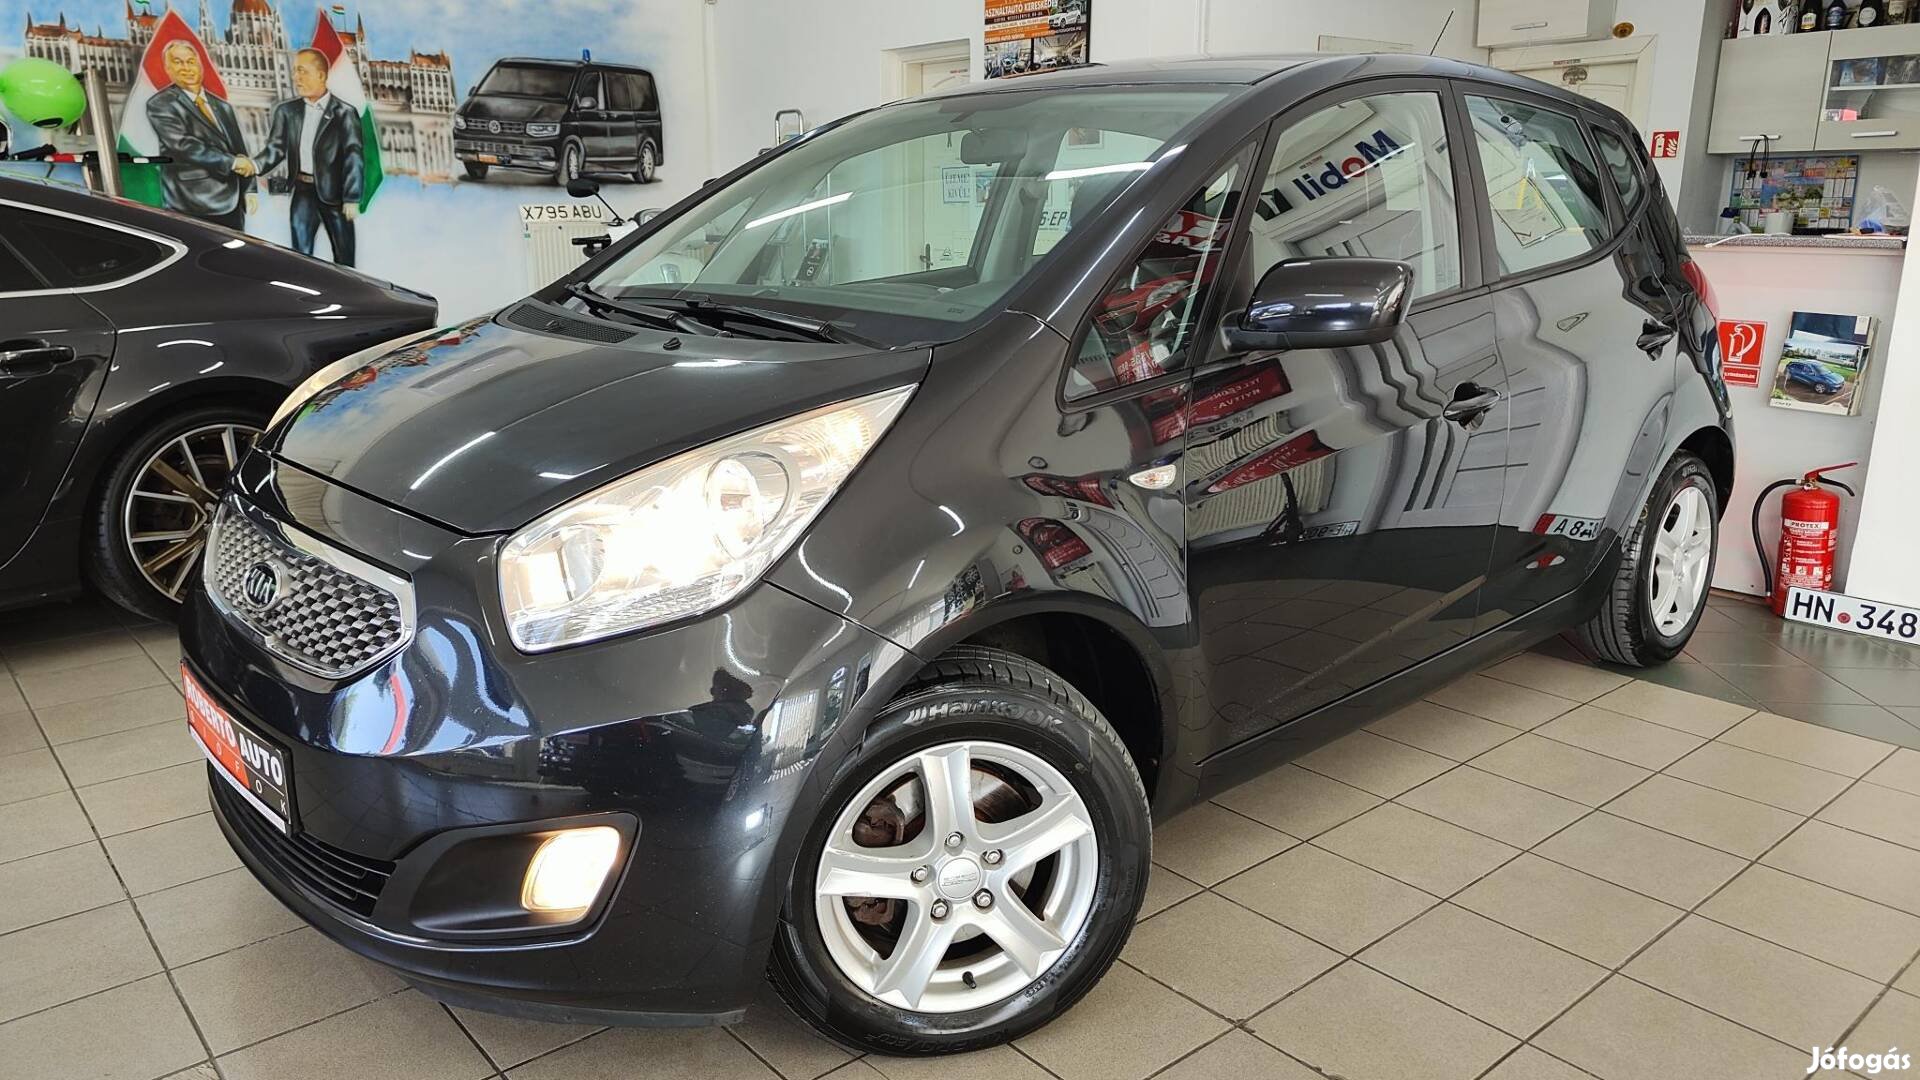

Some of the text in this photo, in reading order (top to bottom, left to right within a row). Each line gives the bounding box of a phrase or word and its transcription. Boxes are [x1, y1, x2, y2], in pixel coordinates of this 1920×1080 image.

[523, 204, 602, 220] X795 ABU
[1792, 592, 1918, 638] HN 348
[184, 673, 283, 786] ROBERTO AUTO
